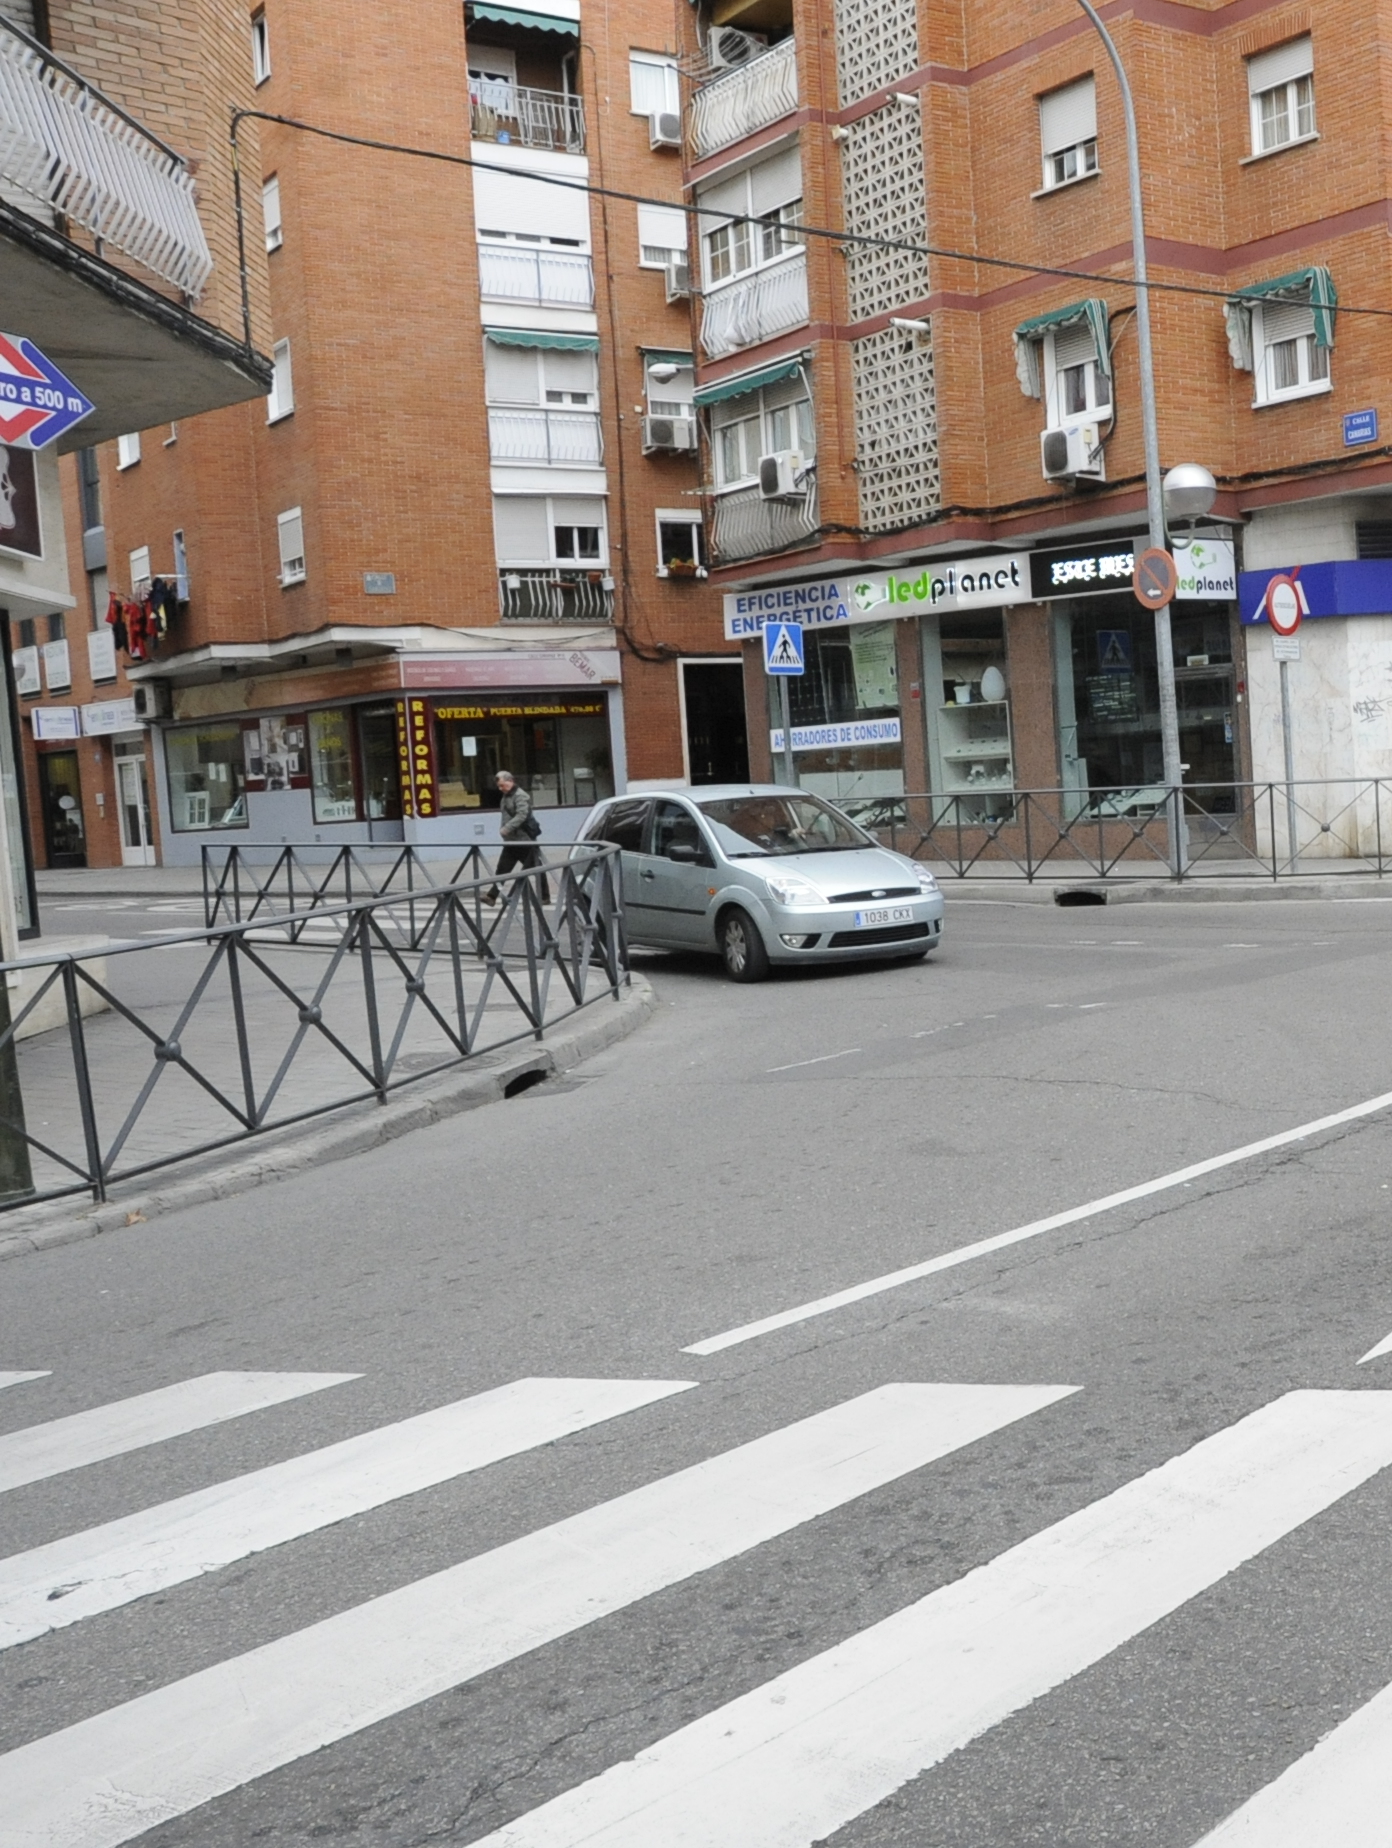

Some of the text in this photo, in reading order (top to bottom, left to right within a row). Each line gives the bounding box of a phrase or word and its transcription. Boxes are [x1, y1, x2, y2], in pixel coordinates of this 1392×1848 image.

[21, 386, 32, 403] a
[34, 386, 64, 409] 500
[67, 396, 82, 413] m
[886, 559, 1021, 605] ledplanet
[1176, 576, 1235, 594] ledplanet
[736, 583, 840, 614] EFICIENCIA
[569, 652, 597, 681] BEMAR
[490, 706, 522, 716] PUERTA
[774, 722, 898, 748] AHRRADORES DE CONSUMO
[397, 702, 411, 815] REFORMAS
[411, 700, 433, 814] REFORMAS
[864, 910, 889, 924] 1038
